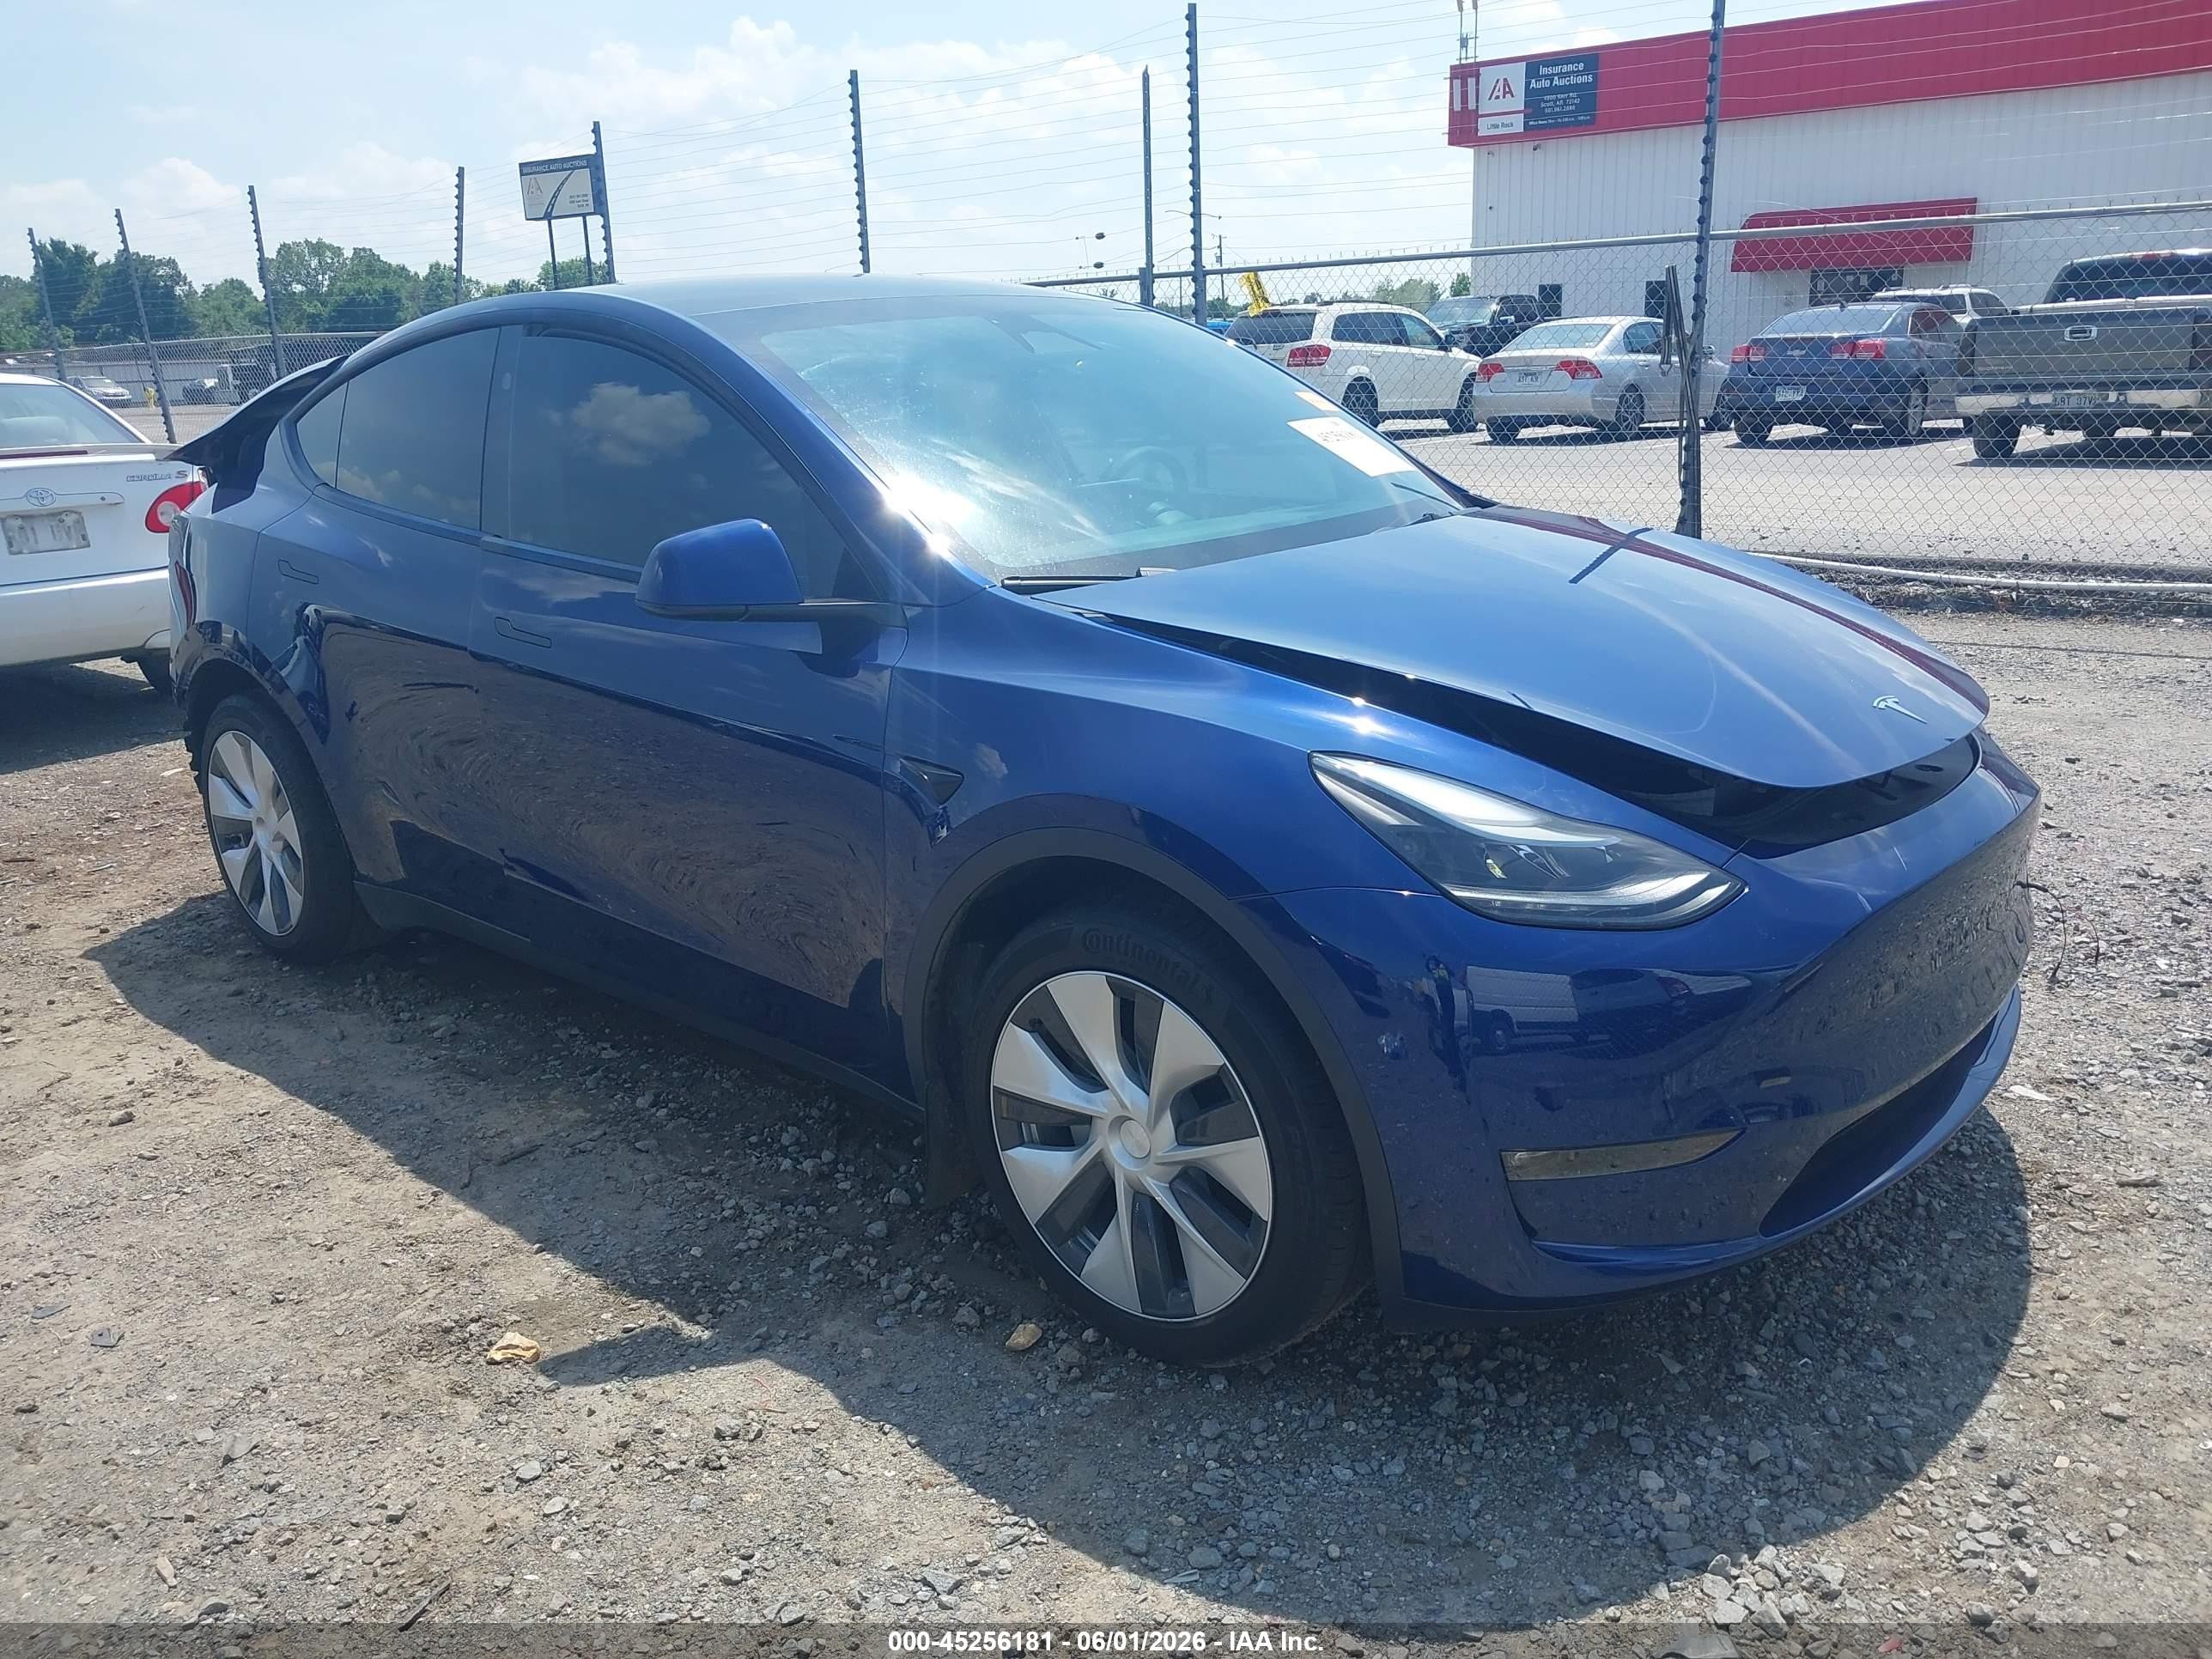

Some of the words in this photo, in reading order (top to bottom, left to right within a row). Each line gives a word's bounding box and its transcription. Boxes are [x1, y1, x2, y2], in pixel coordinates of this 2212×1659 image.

[1540, 62, 1584, 76] Insurance
[1529, 78, 1551, 89] Auto
[1553, 75, 1593, 87] Auctions
[562, 160, 587, 168] AUCTIONS
[174, 470, 187, 478] S
[1082, 927, 1201, 989] Continental
